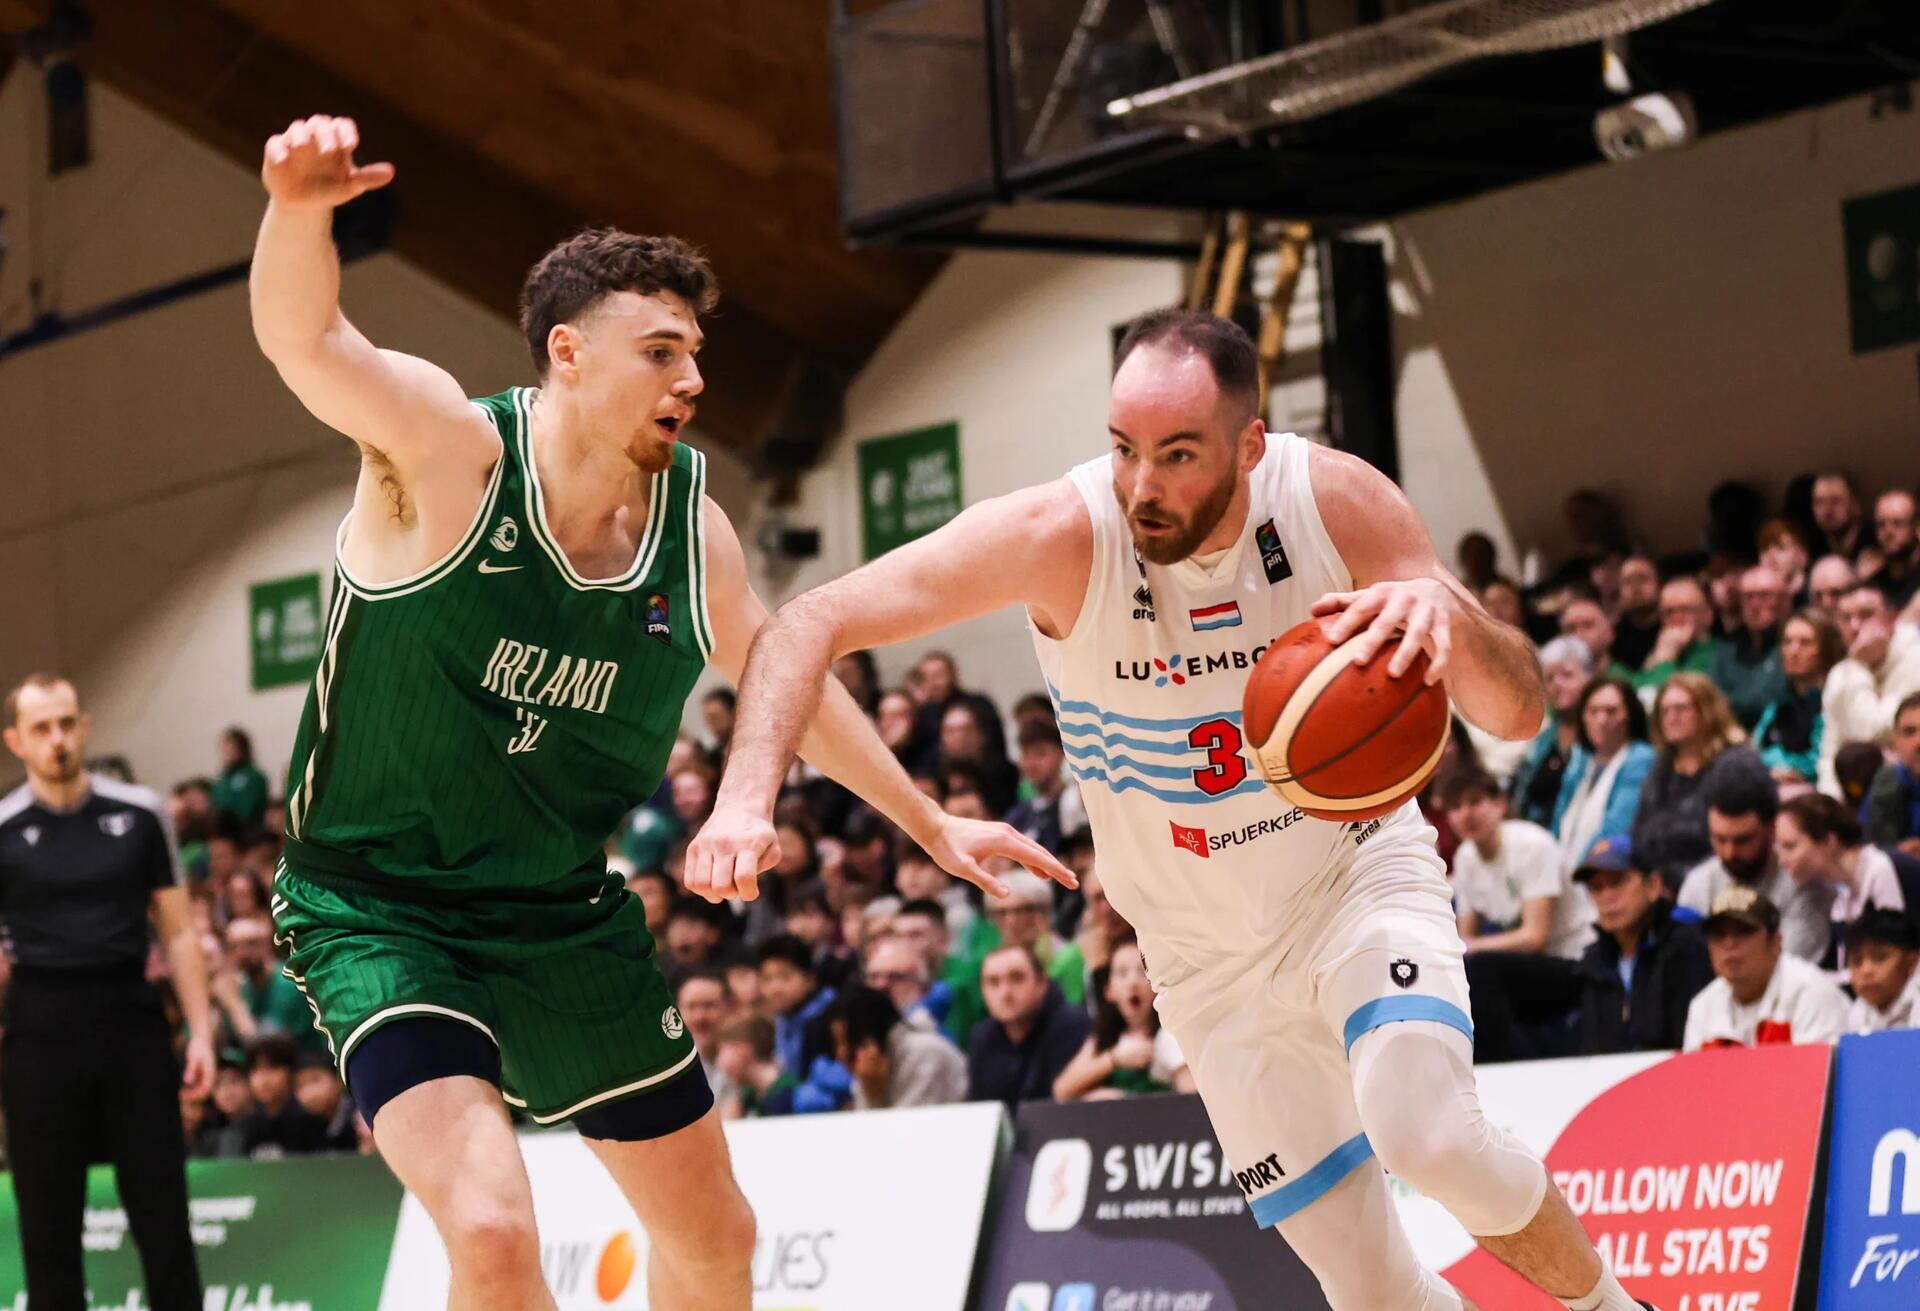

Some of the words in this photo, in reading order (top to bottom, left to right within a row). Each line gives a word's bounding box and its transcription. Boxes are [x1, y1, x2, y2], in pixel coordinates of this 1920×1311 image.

[480, 637, 618, 714] IRELAND
[1116, 639, 1276, 688] LUXEMBO
[1188, 718, 1247, 796] 3
[1208, 805, 1309, 851] SPUERKEE
[1235, 1152, 1287, 1195] PORT
[1552, 1164, 1690, 1216] FOLLOW
[1694, 1158, 1784, 1210] NOW
[1596, 1231, 1653, 1278] ALL
[1659, 1225, 1771, 1277] STATS
[1849, 1233, 1920, 1289] For
